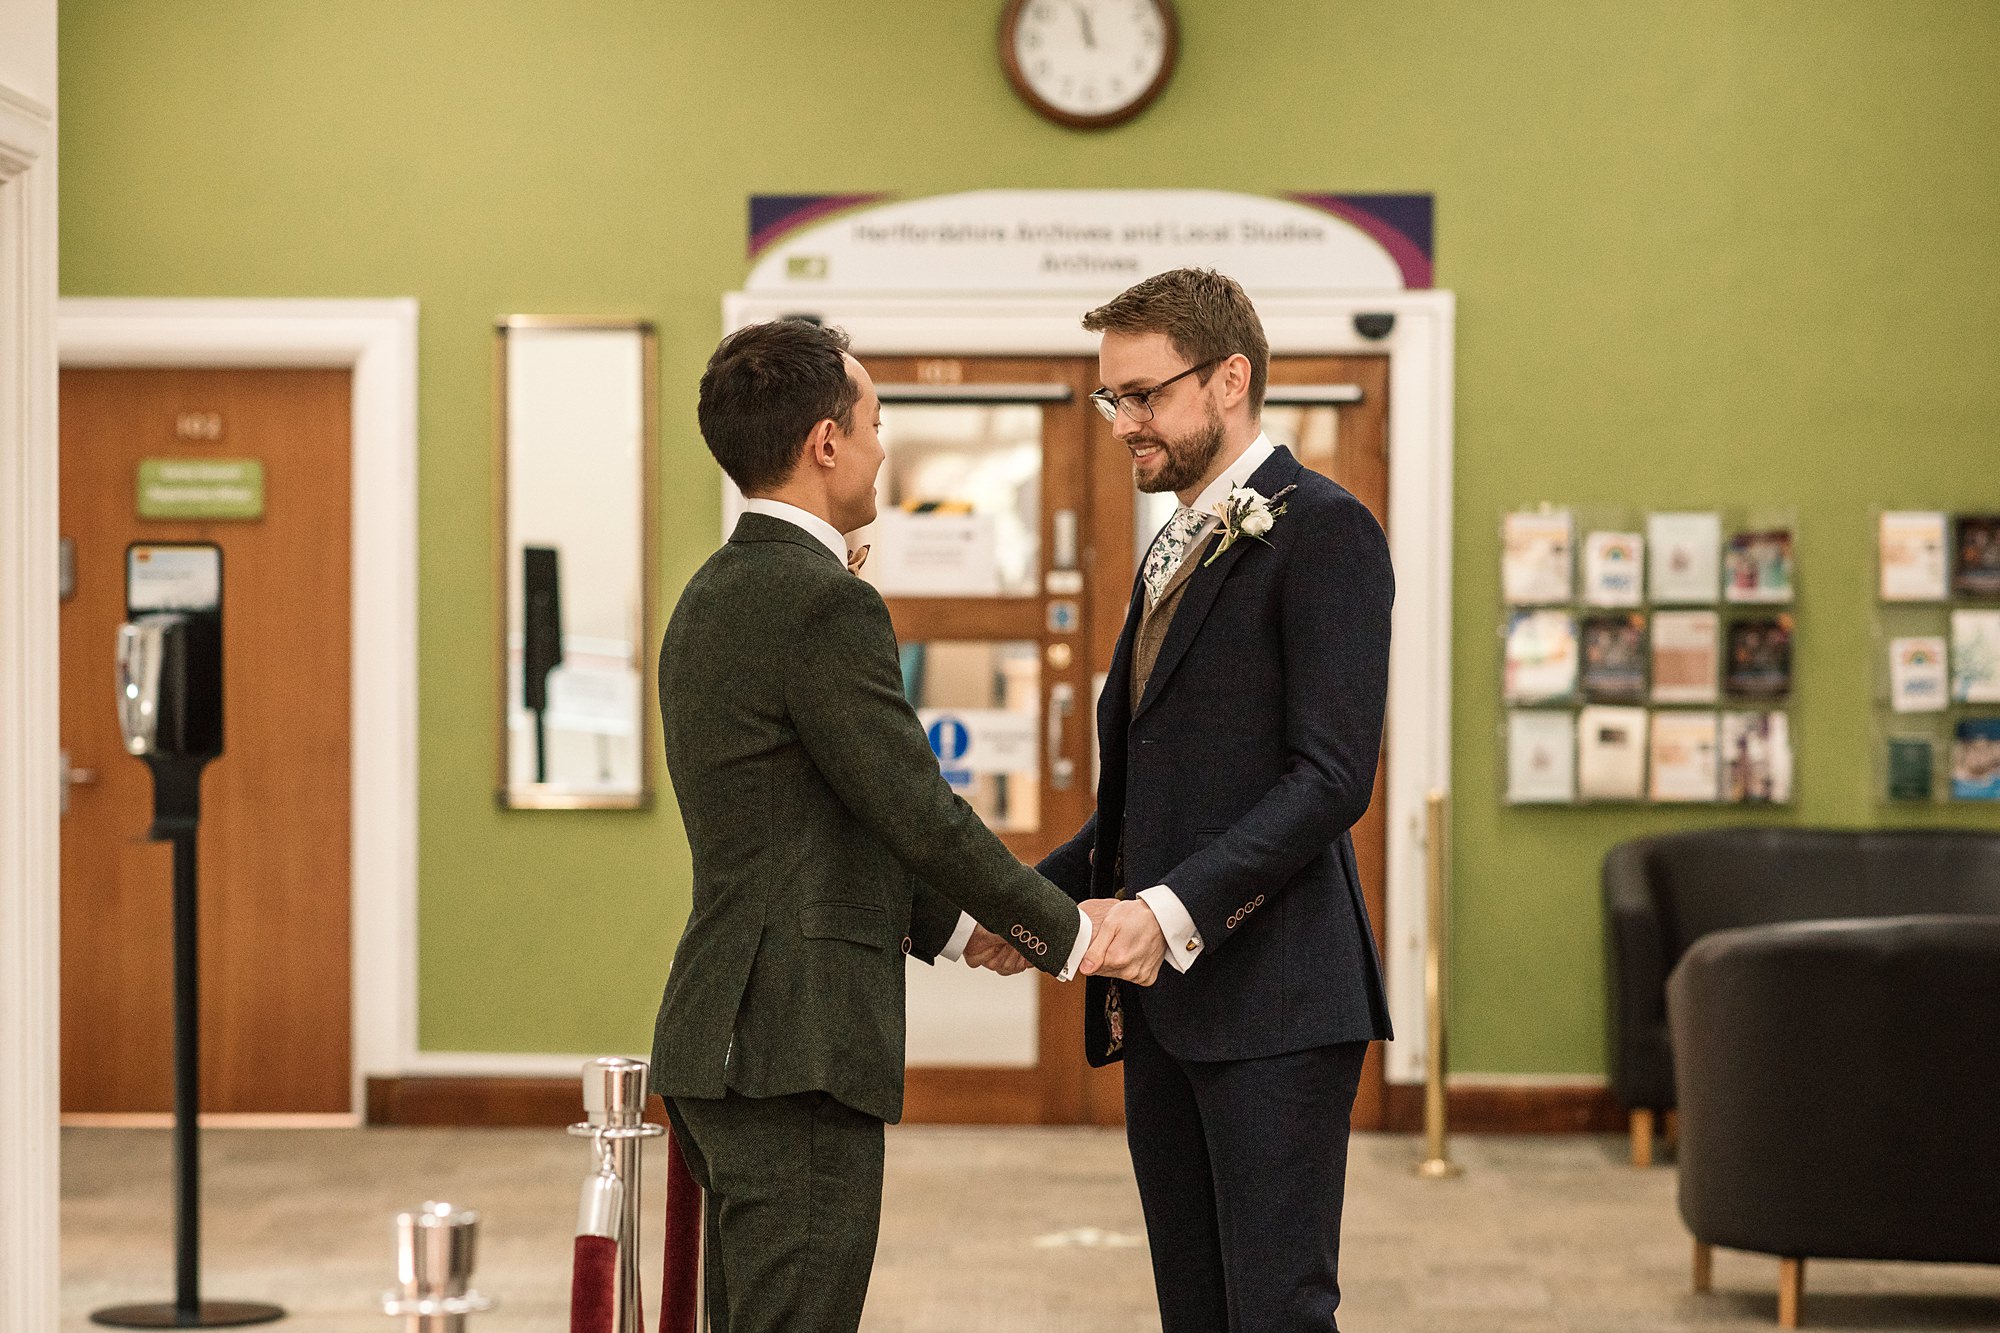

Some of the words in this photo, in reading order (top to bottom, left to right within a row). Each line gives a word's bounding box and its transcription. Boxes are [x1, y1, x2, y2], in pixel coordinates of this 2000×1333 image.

[853, 221, 1008, 244] Hertfordshire
[1014, 221, 1114, 244] Archives
[1119, 221, 1164, 244] and
[1171, 221, 1231, 244] Local
[1239, 221, 1327, 244] Studies
[1039, 251, 1139, 274] Archives
